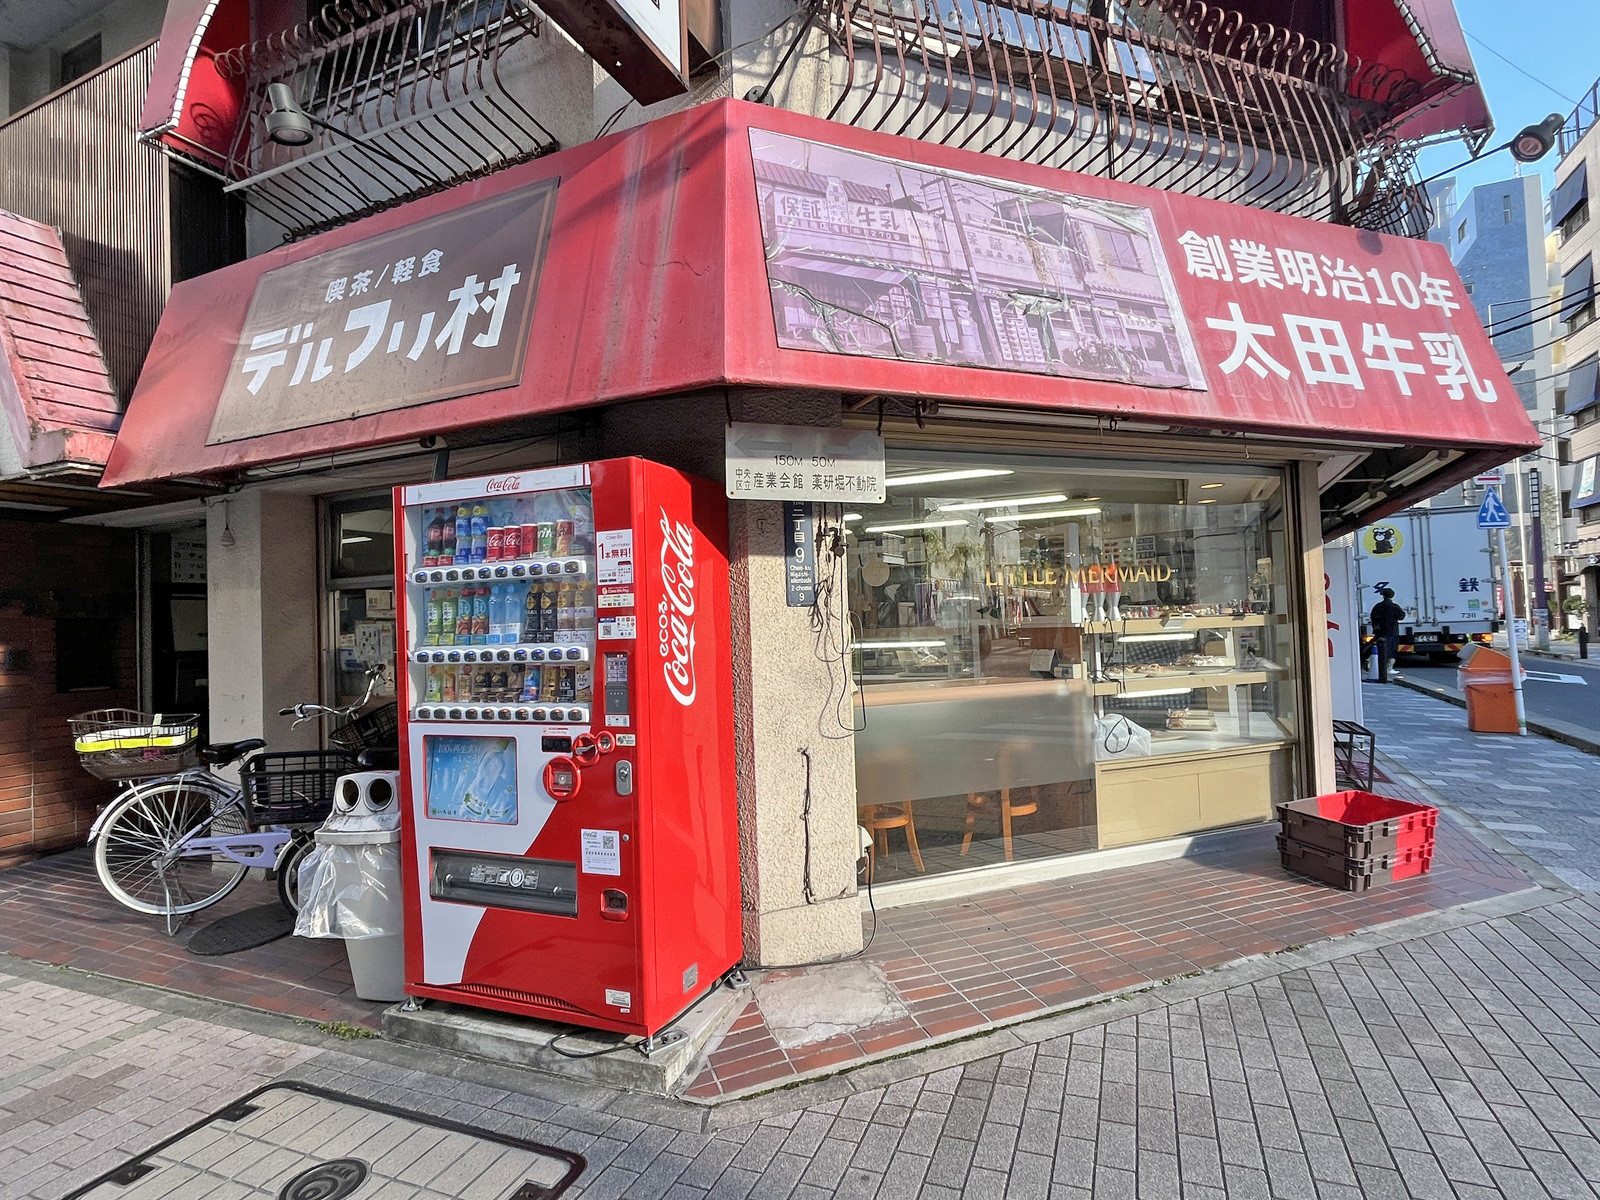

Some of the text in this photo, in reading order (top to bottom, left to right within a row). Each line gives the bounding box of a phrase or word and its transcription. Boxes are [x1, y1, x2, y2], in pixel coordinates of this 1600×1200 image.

[1177, 229, 1462, 318] 創業明治10年
[241, 263, 522, 396] デルフリ村
[1205, 302, 1498, 404] 太田牛乳
[735, 468, 752, 479] 中央
[753, 471, 877, 492] 産業会館 薬研堀不動院
[659, 505, 697, 706] Coca-Cola
[985, 564, 1172, 586] LITTLE MERMAID
